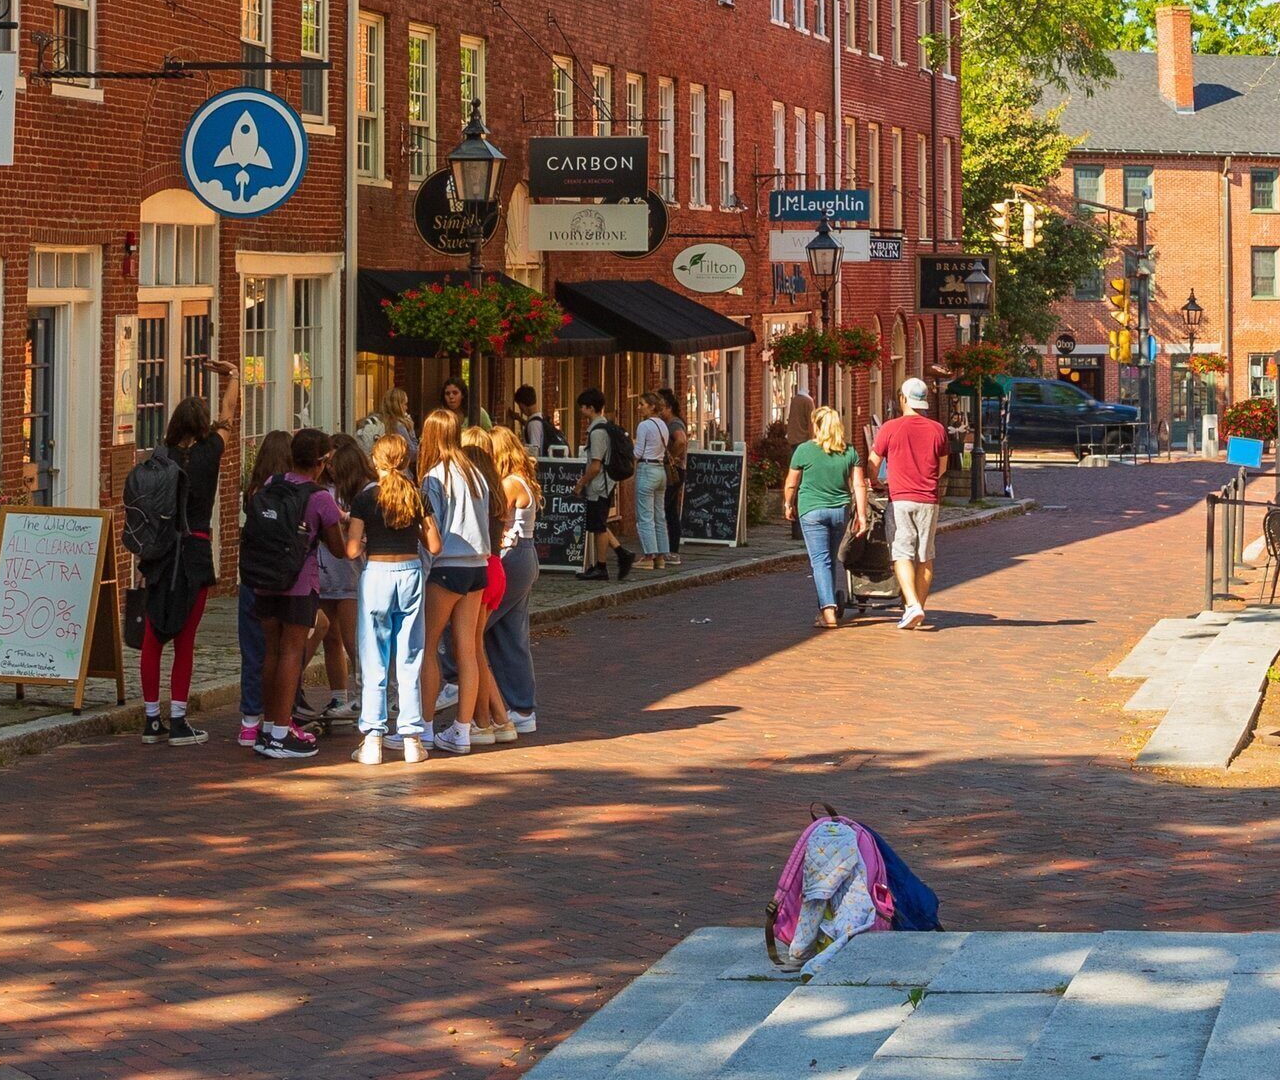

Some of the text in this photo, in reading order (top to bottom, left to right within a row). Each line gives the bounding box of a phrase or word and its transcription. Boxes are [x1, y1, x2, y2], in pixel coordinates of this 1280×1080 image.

[546, 156, 634, 171] CARBON
[775, 194, 864, 217] J.McLaughlin
[438, 234, 471, 249] Swe
[700, 259, 737, 274] Tilton
[936, 262, 974, 271] BRASS
[552, 497, 586, 514] Flavors
[18, 516, 40, 531] The
[43, 516, 65, 531] Wild
[6, 535, 97, 556] ALL CLEARANCE
[55, 622, 82, 643] off
